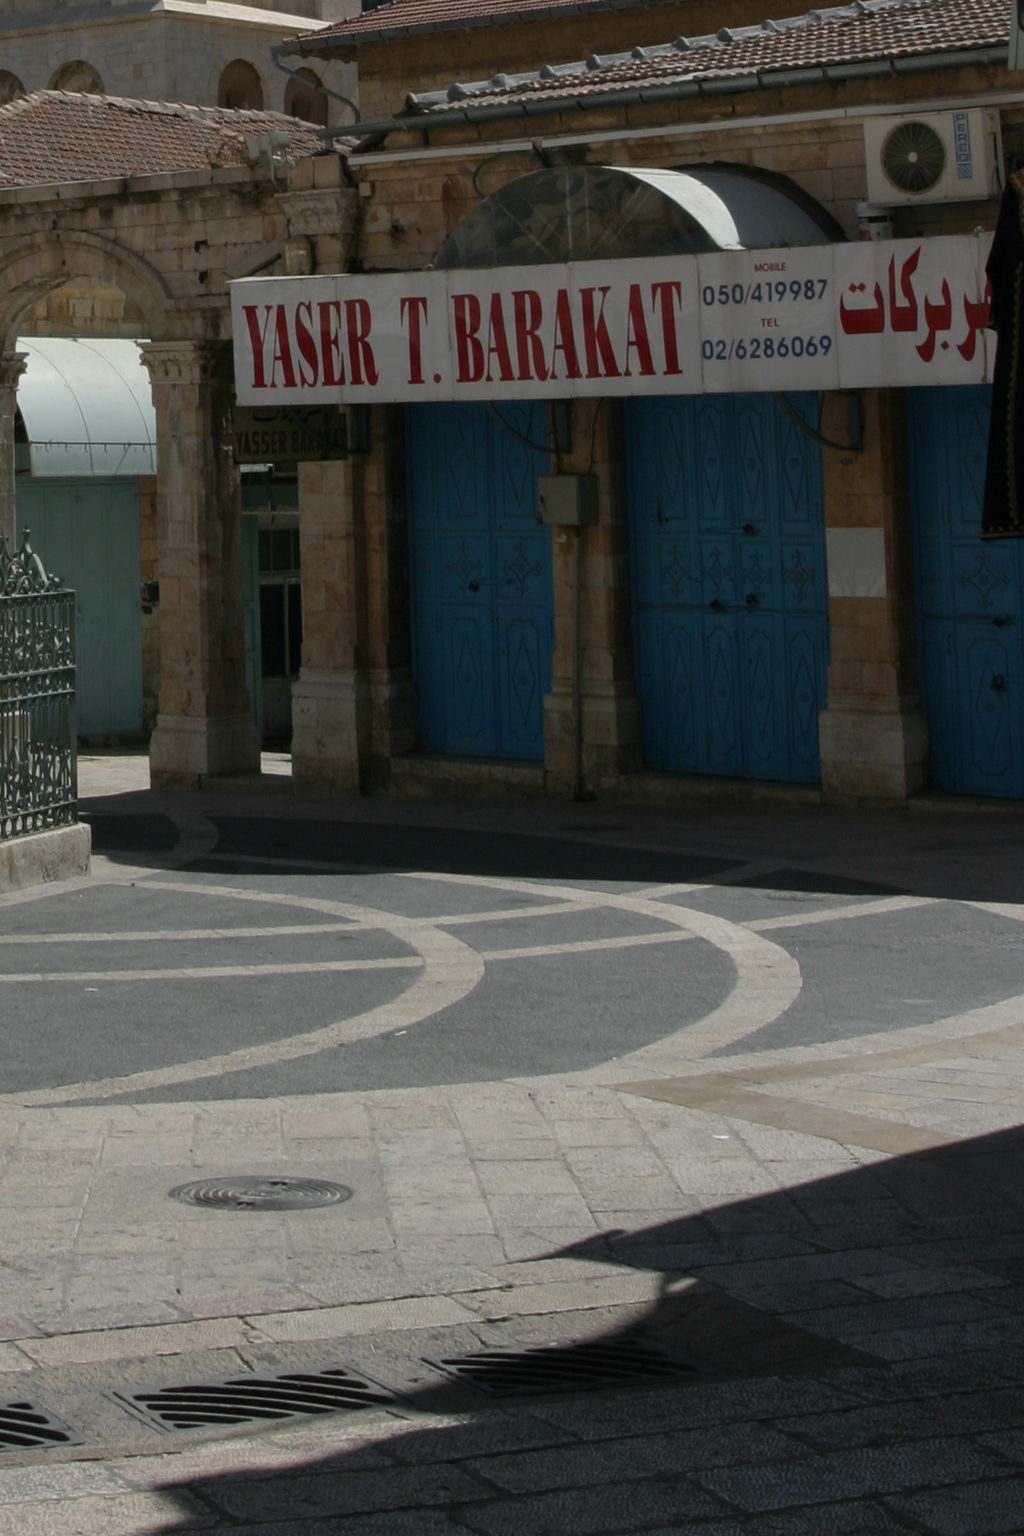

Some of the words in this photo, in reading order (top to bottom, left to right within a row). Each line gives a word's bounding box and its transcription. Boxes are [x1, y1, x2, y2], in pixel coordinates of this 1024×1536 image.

[955, 113, 969, 162] PEREG
[753, 261, 786, 272] MOBILE
[702, 279, 828, 306] 050/419987
[839, 245, 952, 363] بركات
[241, 297, 379, 389] YASER
[400, 295, 442, 385] T.
[451, 281, 684, 384] BARAKAT
[760, 317, 780, 328] TEL
[701, 335, 833, 360] 02/6286069
[235, 429, 287, 455] YASSER
[291, 428, 347, 453] BARAAT
